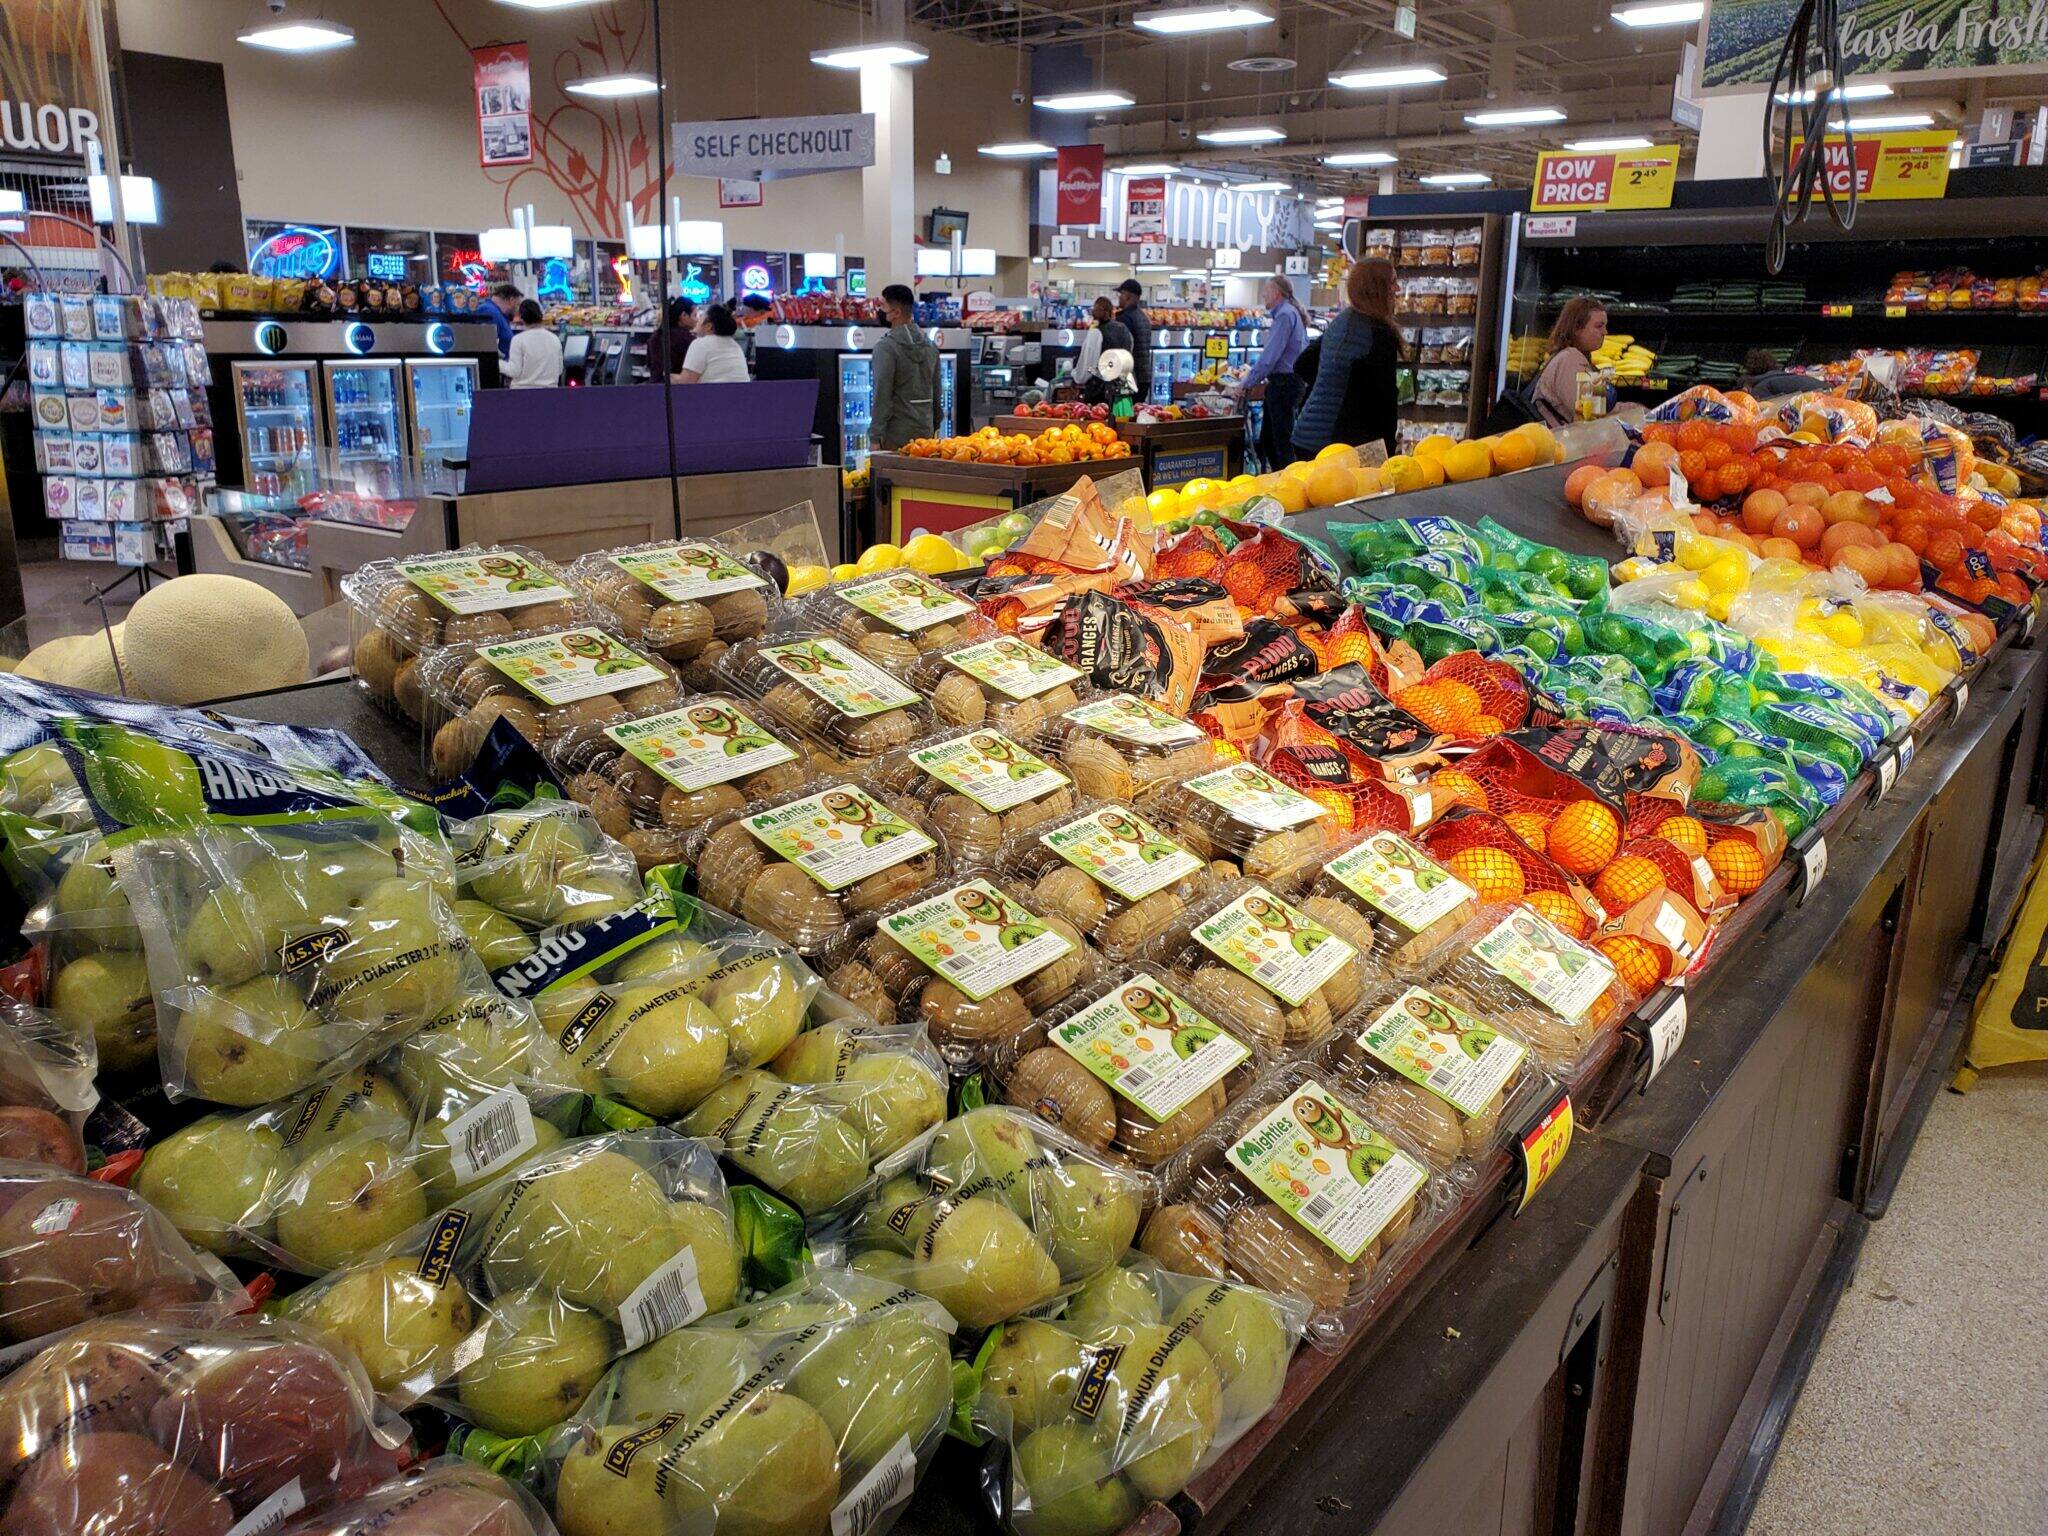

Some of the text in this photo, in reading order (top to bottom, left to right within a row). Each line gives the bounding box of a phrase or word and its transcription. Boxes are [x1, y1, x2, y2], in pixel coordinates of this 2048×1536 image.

[1839, 10, 1949, 59] laska
[0, 101, 103, 153] UOR
[694, 129, 853, 158] SELF CHECKOUT
[1546, 160, 1596, 180] LOW
[1543, 182, 1606, 202] PRICE
[1159, 459, 1197, 471] GUARANTEED
[1417, 519, 1447, 545] LIMES
[488, 640, 556, 657] Mighties
[1081, 616, 1098, 674] ORANGES
[615, 715, 683, 737] Mighties
[1791, 704, 1837, 726] LIMES
[921, 742, 969, 764] Mighties
[752, 802, 820, 830] Mighties
[1048, 820, 1099, 846] Mighties
[888, 901, 951, 932] Mighties
[1199, 908, 1246, 942] Mighties
[363, 951, 424, 984] DIAMETER
[581, 1023, 629, 1068] MINIMUM
[629, 990, 679, 1023] DIAMETER
[707, 967, 725, 982] NET
[727, 962, 742, 975] WT
[742, 959, 753, 970] 32
[753, 953, 766, 966] OZ
[582, 1005, 602, 1025] NO.
[1059, 1004, 1120, 1043] Mighties
[1363, 1011, 1408, 1051] Mighties
[745, 1097, 781, 1157] MINIMUM
[1236, 1117, 1293, 1166] Mighties
[426, 1255, 446, 1281] U.S.
[441, 1227, 458, 1252] NO.
[1121, 1367, 1159, 1436] MINIMUM
[1150, 1321, 1194, 1368] DIAMETER
[1205, 1289, 1225, 1306] NET
[1081, 1353, 1113, 1409] U.S. NO.
[654, 1431, 701, 1499] MINIMUM
[700, 1372, 764, 1431] DIAMETER
[798, 1322, 822, 1343] NET
[612, 1438, 639, 1466] U.S.
[639, 1425, 664, 1444] NO.
